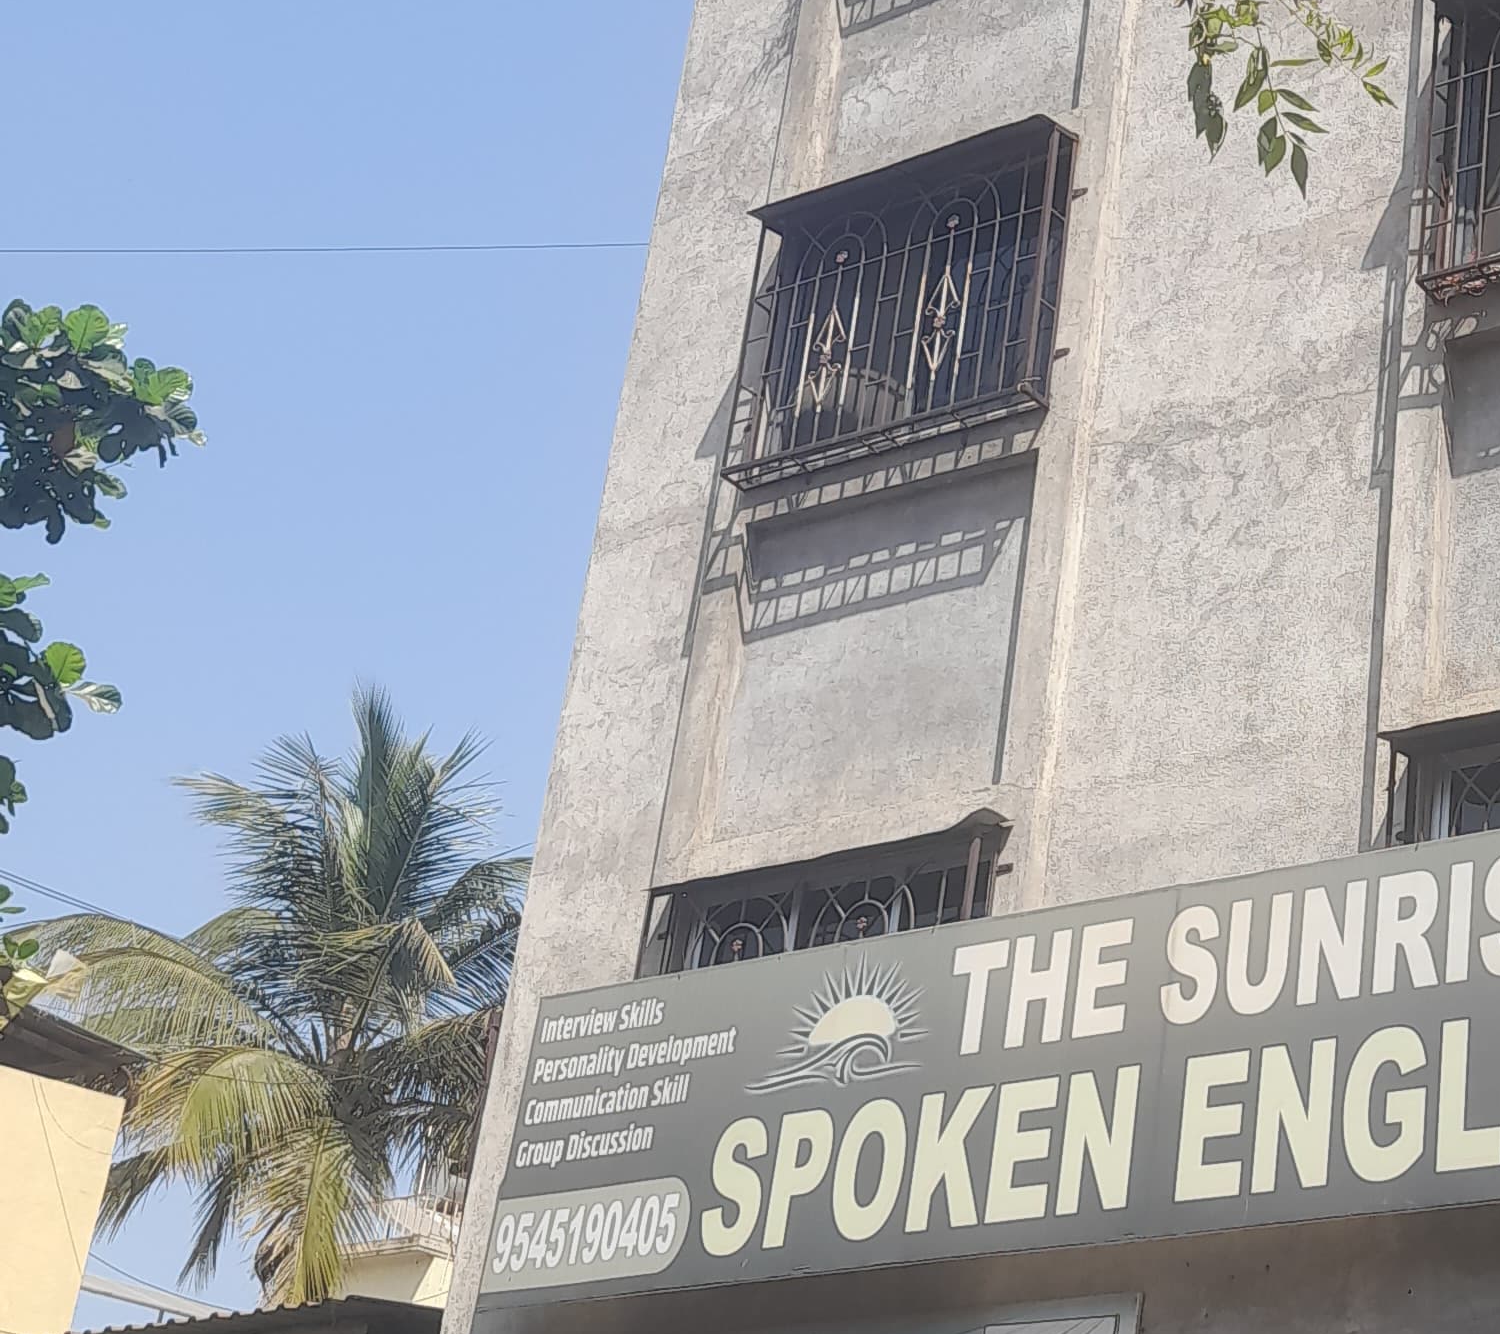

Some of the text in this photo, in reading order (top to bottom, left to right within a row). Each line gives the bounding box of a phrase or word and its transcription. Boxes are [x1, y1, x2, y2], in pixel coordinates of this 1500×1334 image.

[953, 918, 1135, 1056] THE
[540, 998, 666, 1044] Interview Skills
[532, 1026, 738, 1085] Personality Development
[524, 1072, 692, 1126] Communication Skill
[515, 1123, 655, 1170] Group Discussion
[701, 1063, 1142, 1258] SPOKEN
[492, 1193, 681, 1275] 9545190405
